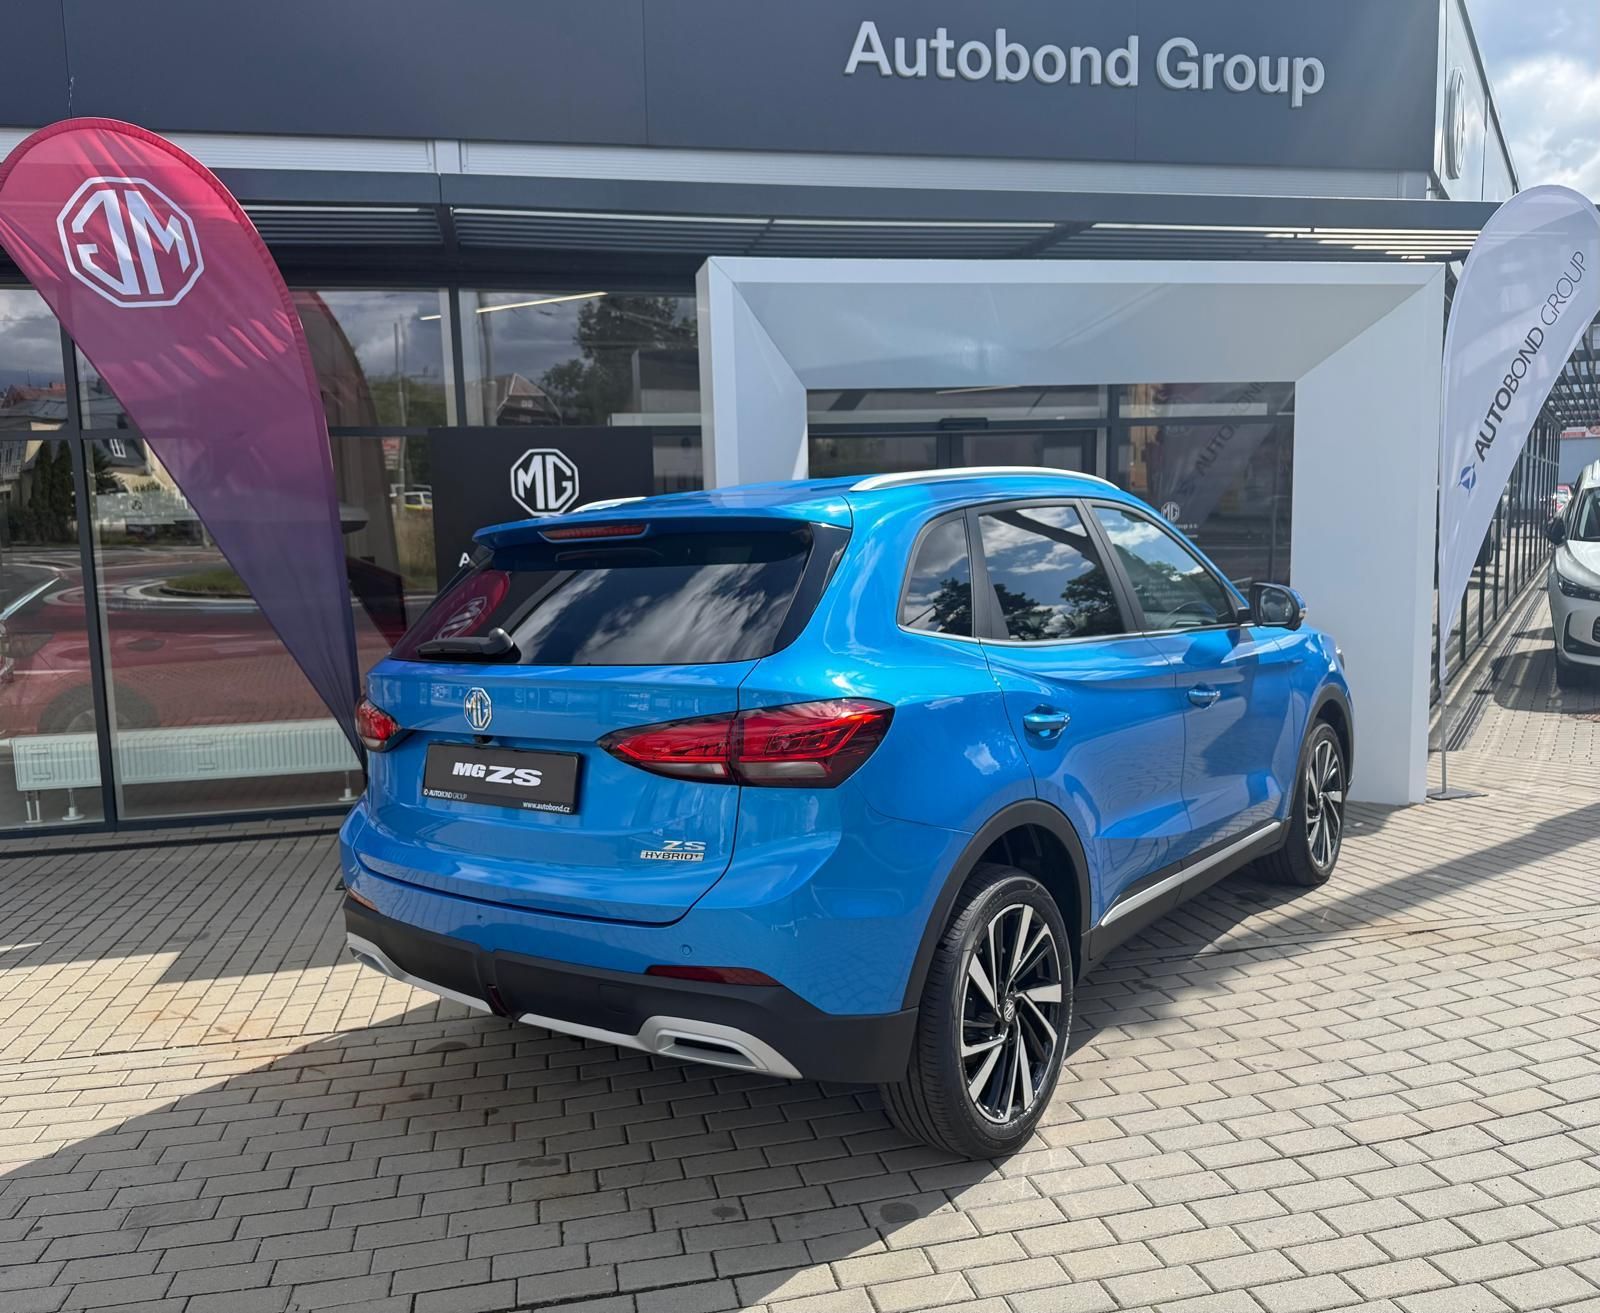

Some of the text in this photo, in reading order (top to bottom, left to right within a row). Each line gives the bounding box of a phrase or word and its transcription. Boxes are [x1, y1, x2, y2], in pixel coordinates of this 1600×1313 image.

[844, 20, 1326, 108] Autobond Group
[1474, 251, 1586, 463] AUTOBOND GROUP
[516, 453, 574, 511] MG
[465, 690, 490, 728] MG
[452, 761, 543, 787] MG ZS
[522, 801, 571, 813] www.autobond.cz
[662, 840, 706, 851] ZS
